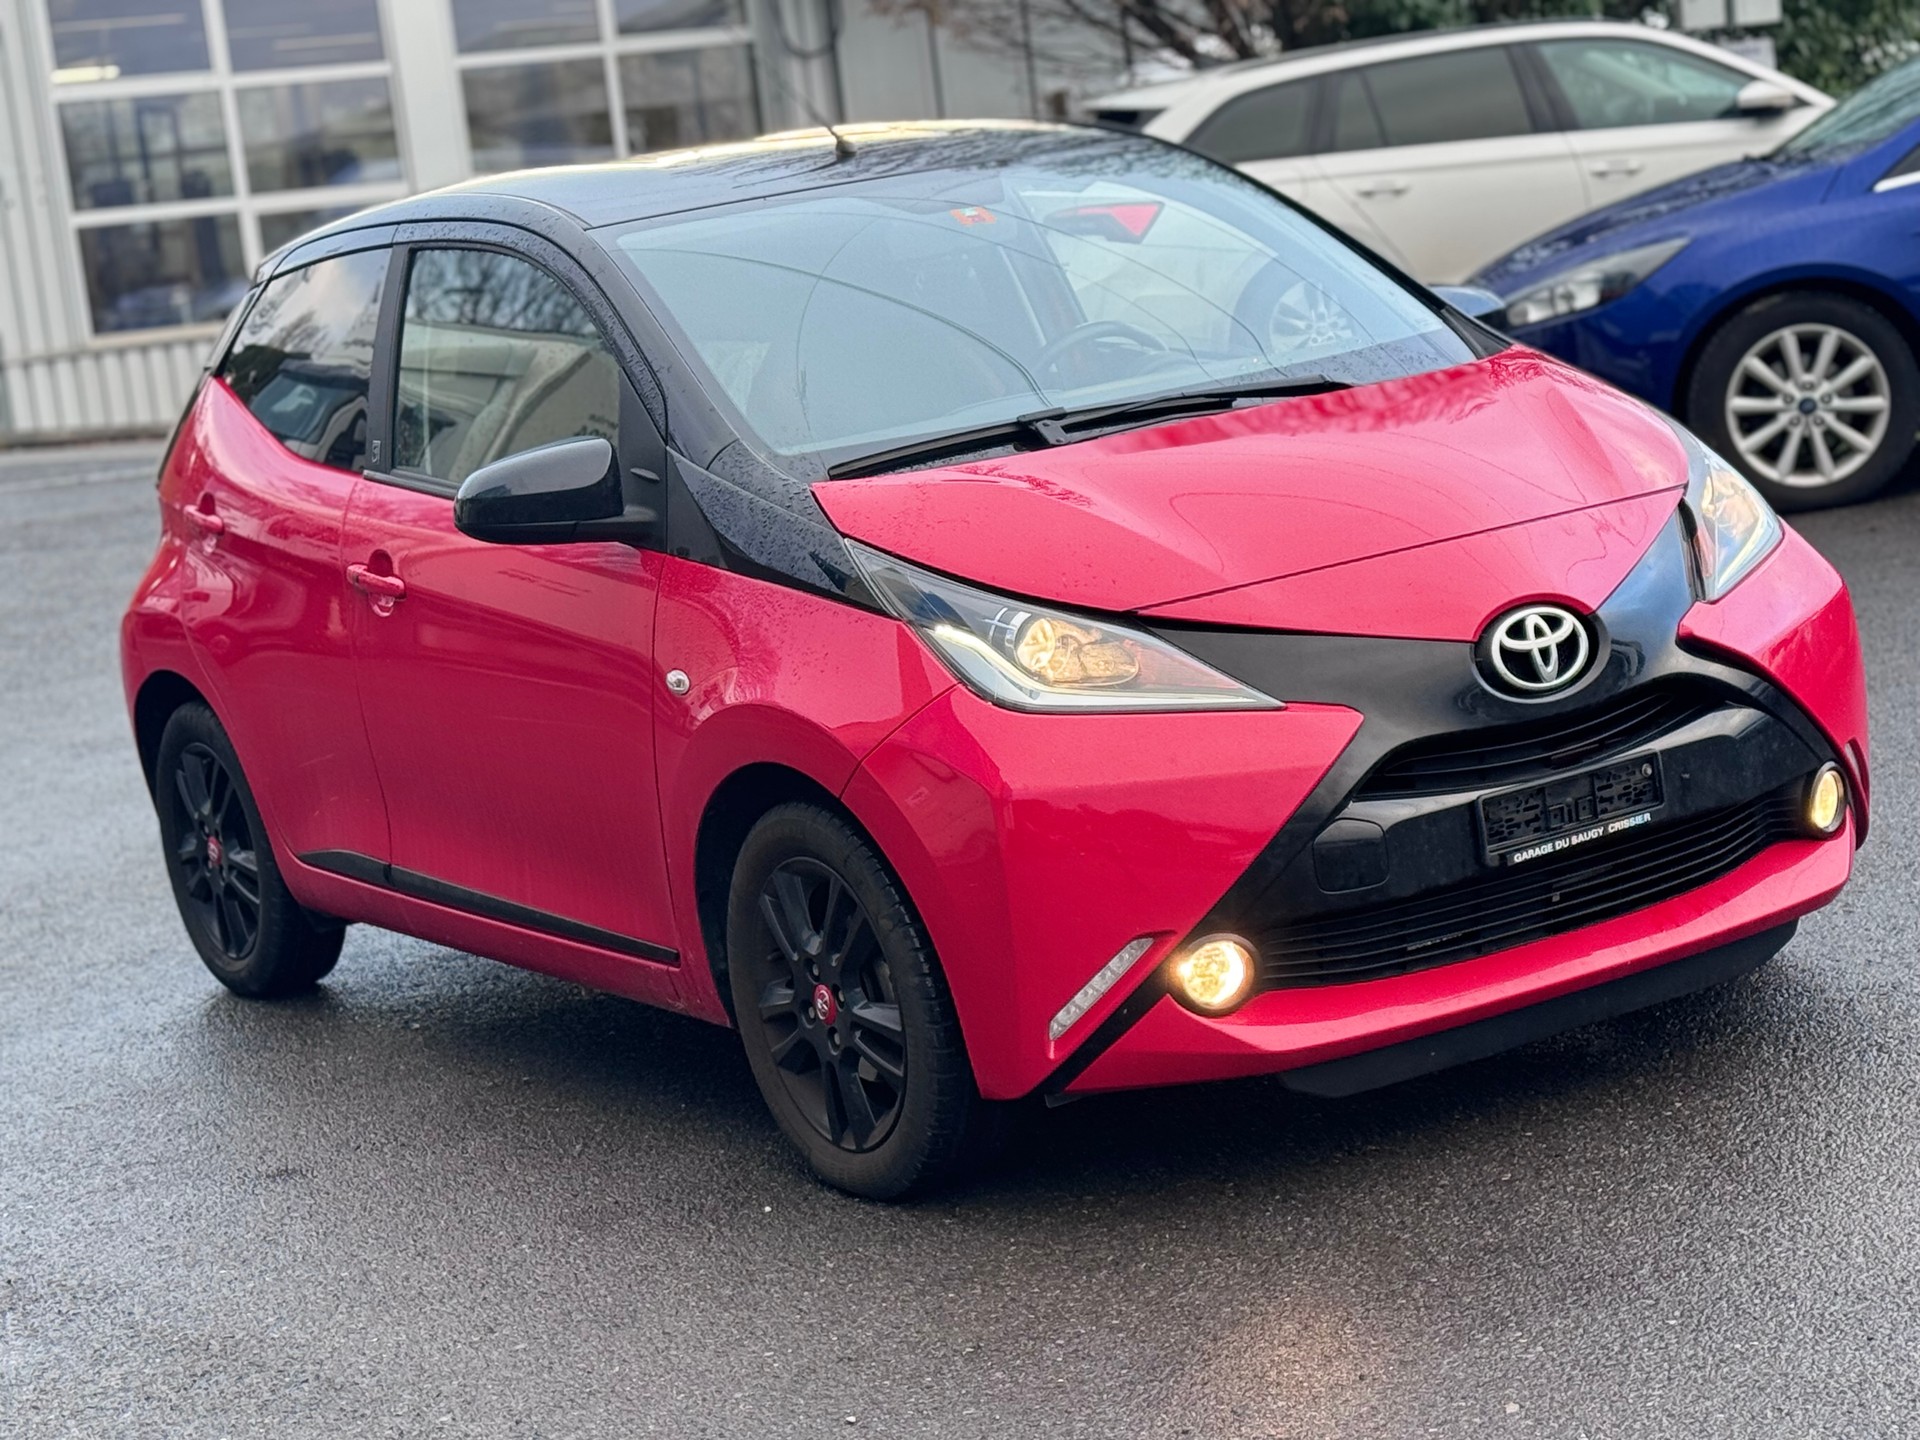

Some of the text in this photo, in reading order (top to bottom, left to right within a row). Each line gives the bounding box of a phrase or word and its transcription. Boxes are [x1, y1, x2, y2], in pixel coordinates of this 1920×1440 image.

[1513, 843, 1554, 862] GARAGE
[1555, 838, 1570, 850] DU
[1608, 812, 1651, 833] CRISSIER
